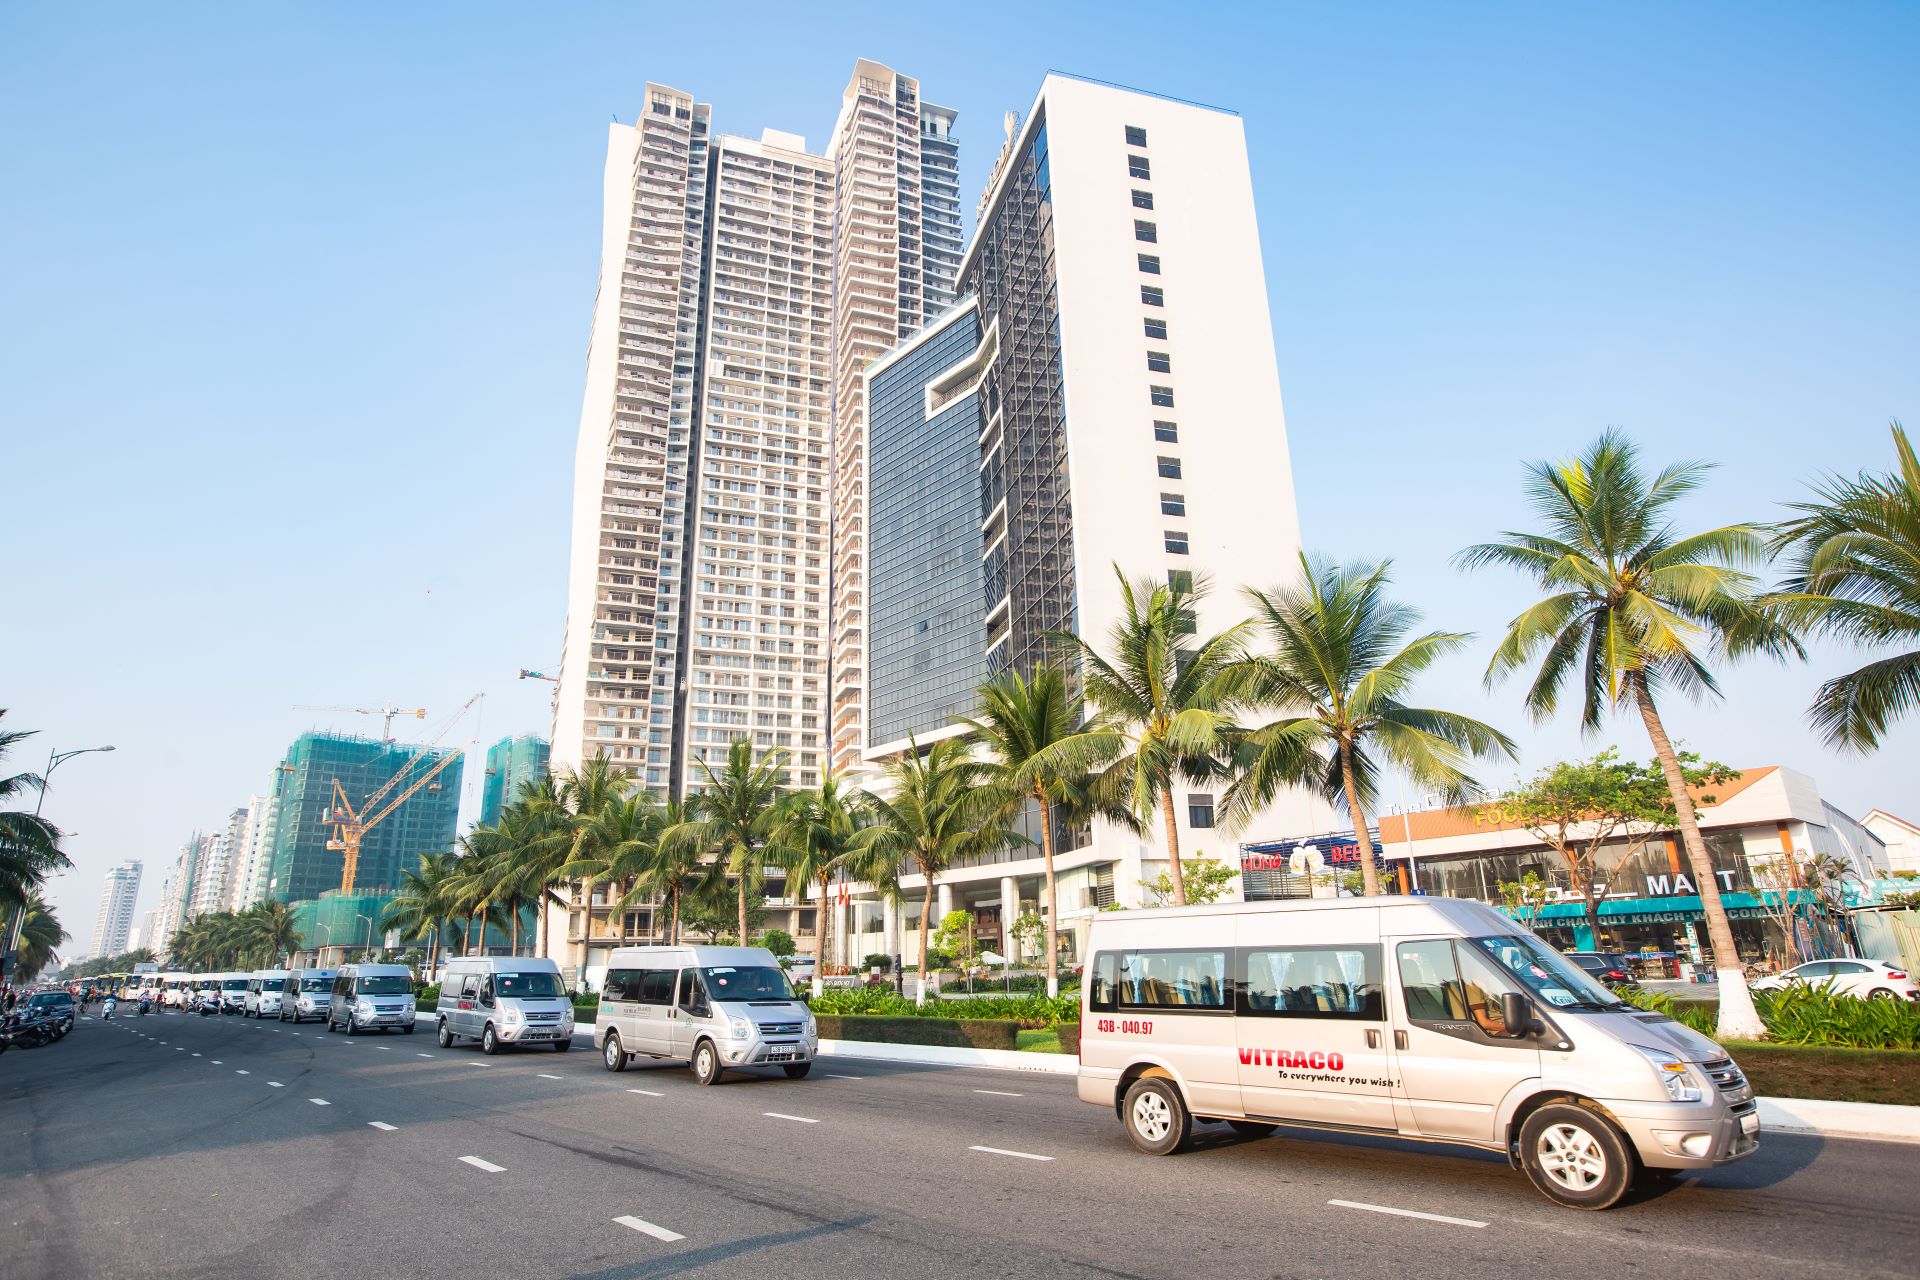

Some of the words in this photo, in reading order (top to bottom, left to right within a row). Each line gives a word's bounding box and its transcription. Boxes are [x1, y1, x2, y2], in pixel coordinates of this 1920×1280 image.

[1331, 843, 1361, 863] BEE
[1646, 869, 1736, 896] MAT
[1098, 1020, 1115, 1032] 43B
[1238, 1048, 1344, 1071] VITRACO
[1278, 1070, 1288, 1079] To
[1290, 1071, 1346, 1083] everywhere
[1349, 1077, 1367, 1085] you
[1370, 1077, 1394, 1087] wish
